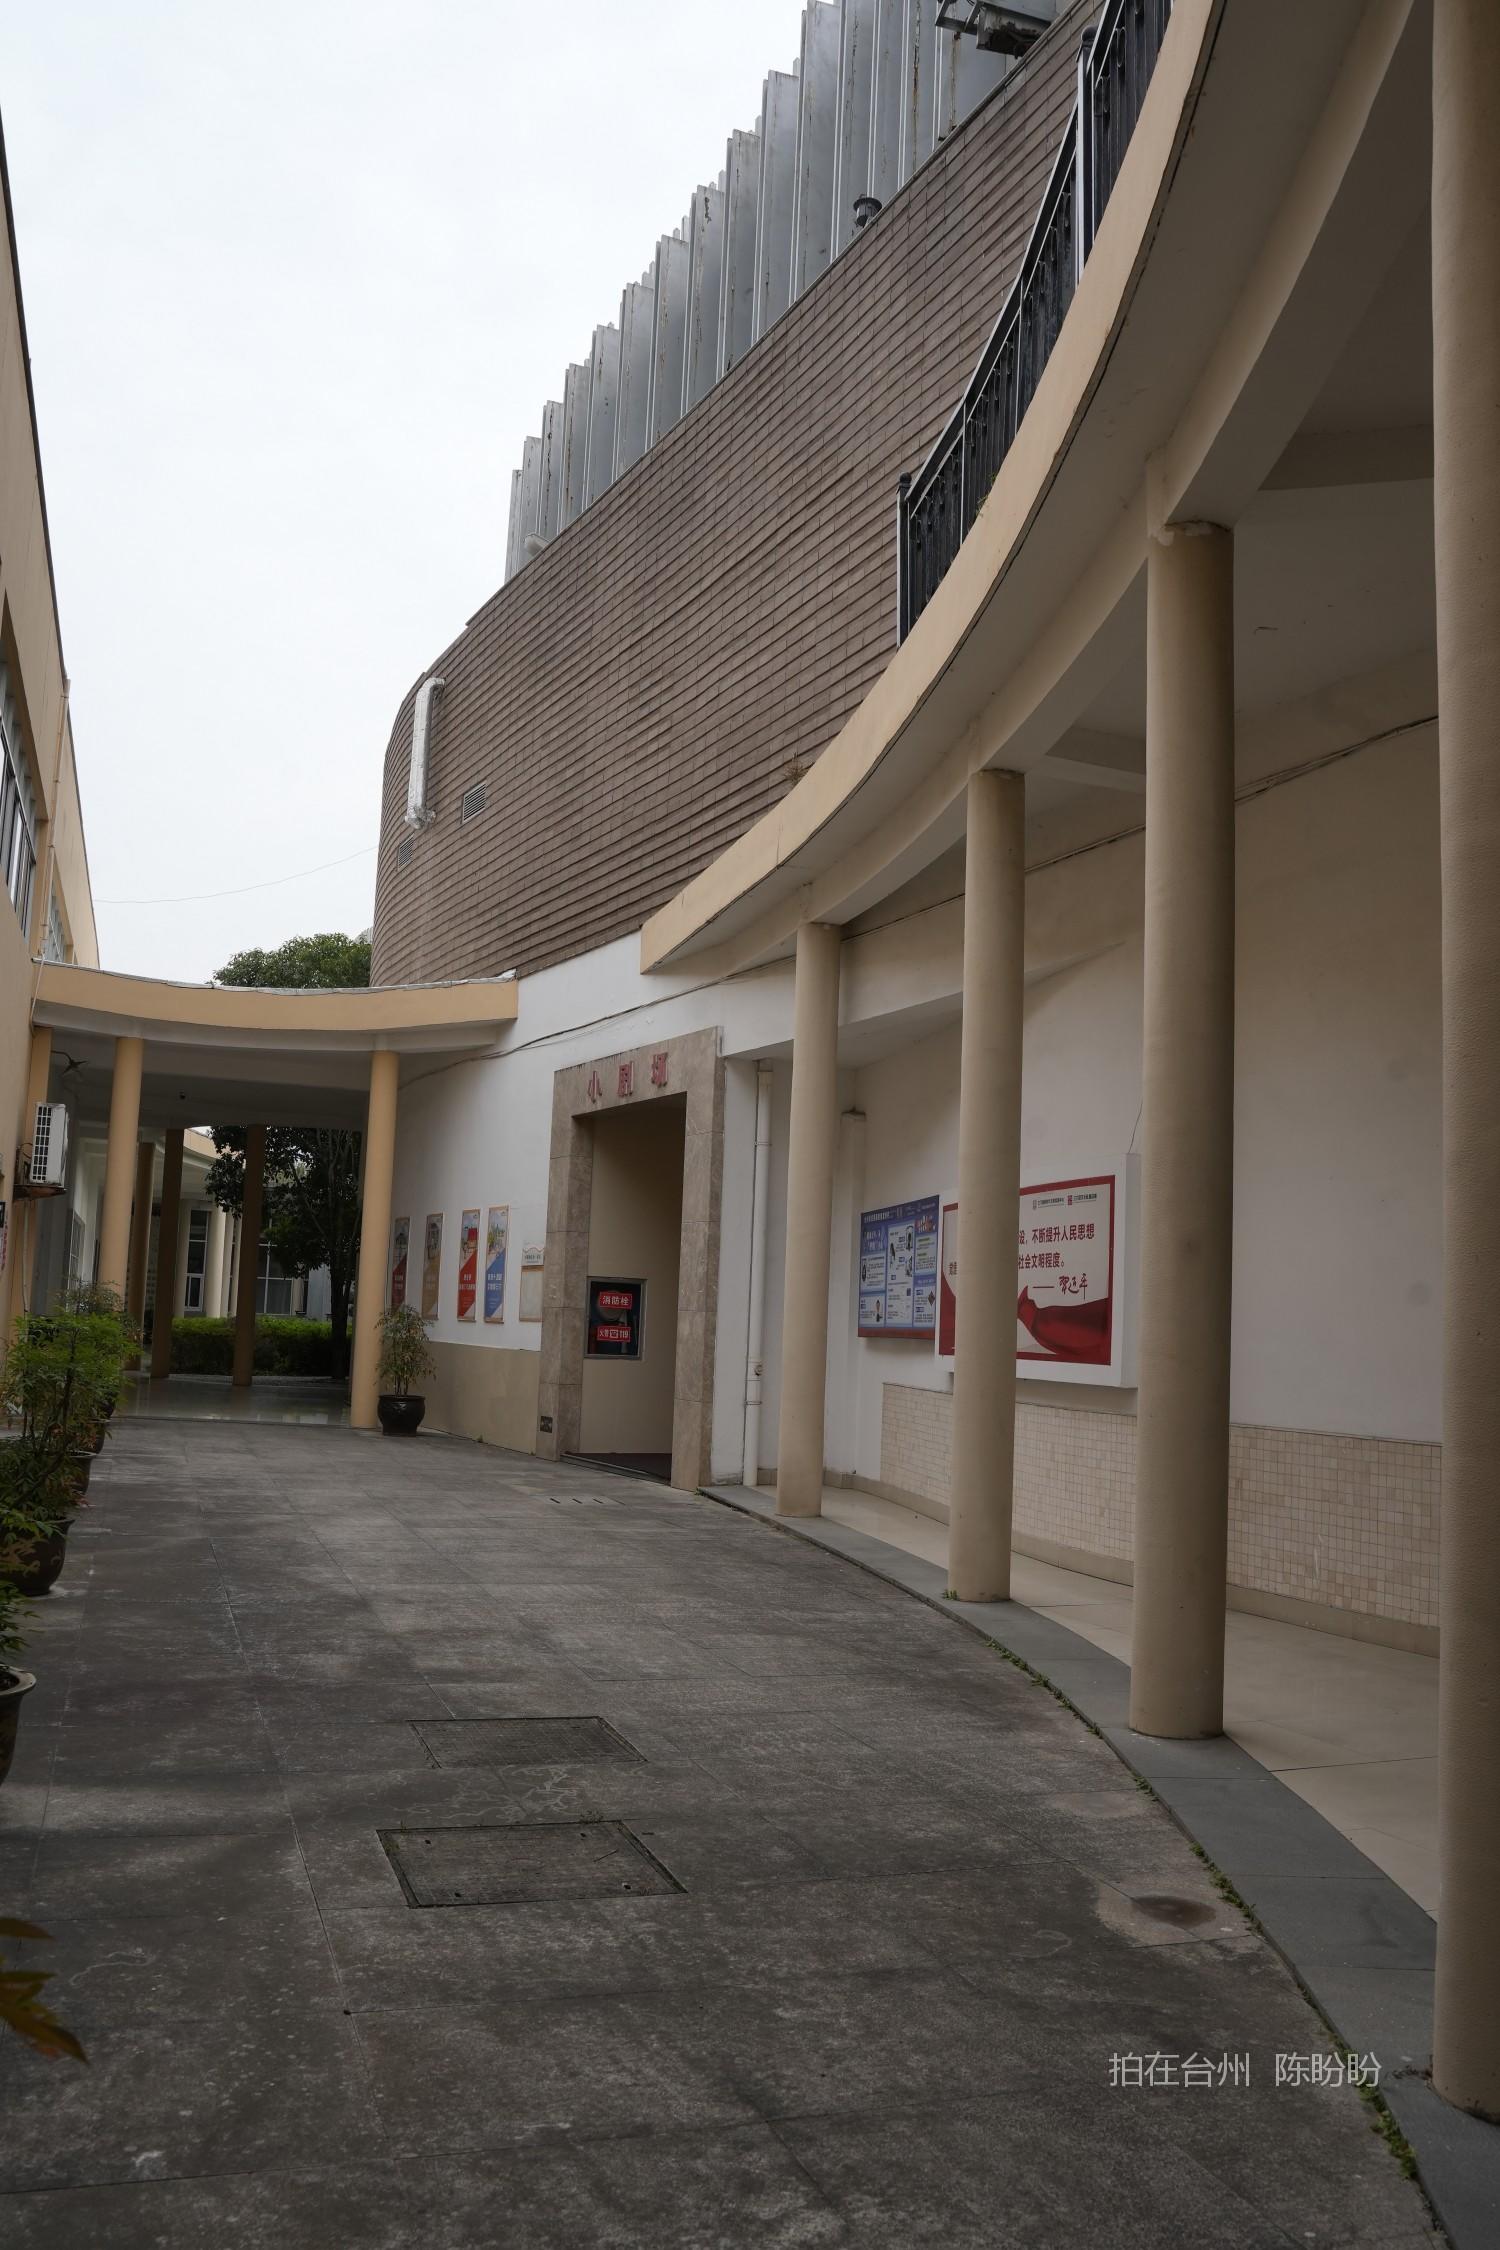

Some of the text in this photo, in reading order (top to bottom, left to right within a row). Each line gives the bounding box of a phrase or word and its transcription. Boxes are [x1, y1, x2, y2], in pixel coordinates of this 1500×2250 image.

[587, 1052, 669, 1104] 小剧场
[602, 1295, 630, 1307] 消防栓
[619, 1330, 629, 1339] 119
